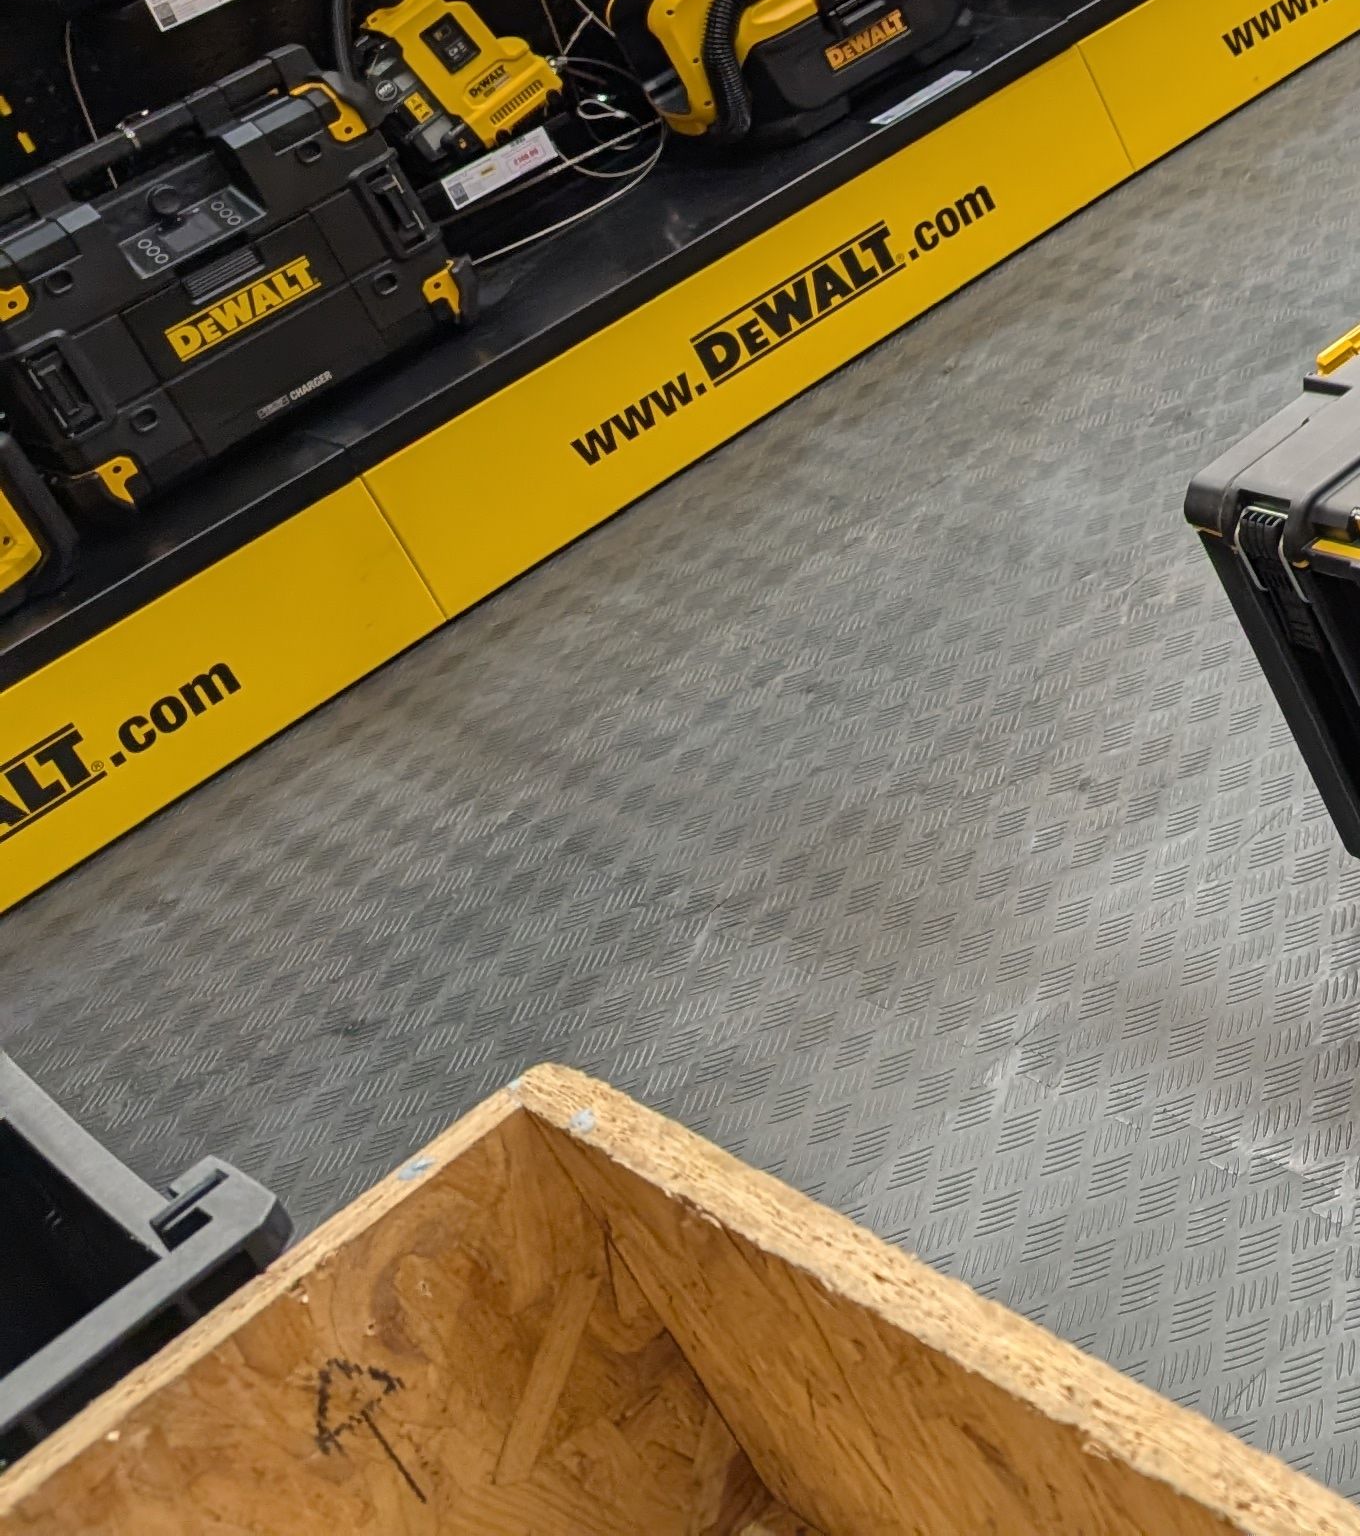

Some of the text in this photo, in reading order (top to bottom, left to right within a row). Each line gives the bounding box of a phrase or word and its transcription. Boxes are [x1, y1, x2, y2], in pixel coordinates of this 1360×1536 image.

[826, 9, 911, 72] DEWALT
[468, 65, 507, 98] DEWALT
[164, 256, 322, 362] DEWALT
[569, 184, 996, 468] www.DEWALT.com
[289, 370, 333, 401] CHARGER
